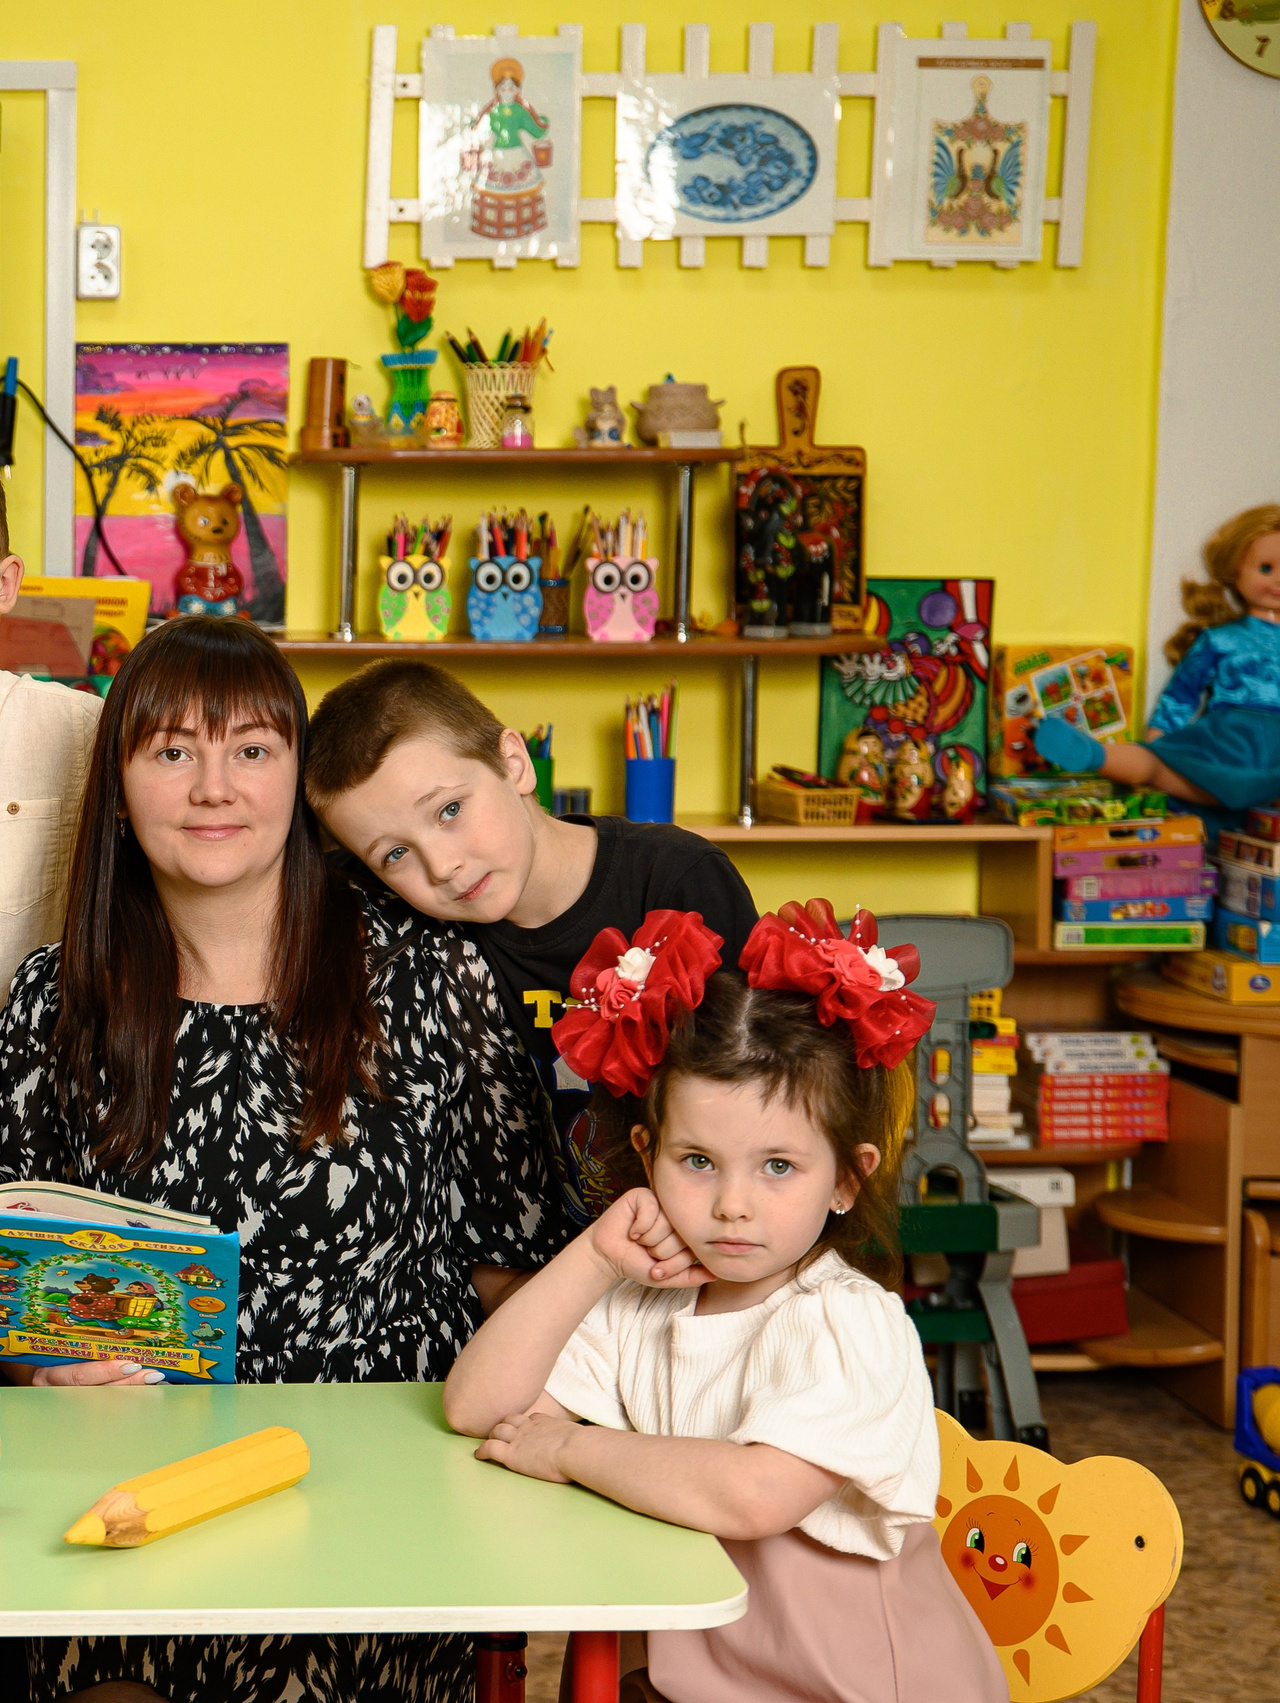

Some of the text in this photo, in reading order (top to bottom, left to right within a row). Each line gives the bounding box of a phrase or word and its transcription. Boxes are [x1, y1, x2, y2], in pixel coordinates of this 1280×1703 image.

[1255, 35, 1271, 58] 7
[7, 1230, 65, 1240] ЛУЧШИХ
[88, 1232, 106, 1244] 7
[68, 1239, 129, 1250] СКАЗОК
[145, 1243, 194, 1252] СТИХАХ
[16, 1335, 91, 1349] РУССКИЕ
[97, 1344, 193, 1359] НАРОДНЫЕ
[31, 1344, 180, 1367] СКАЗКИ В СТИХАХ
